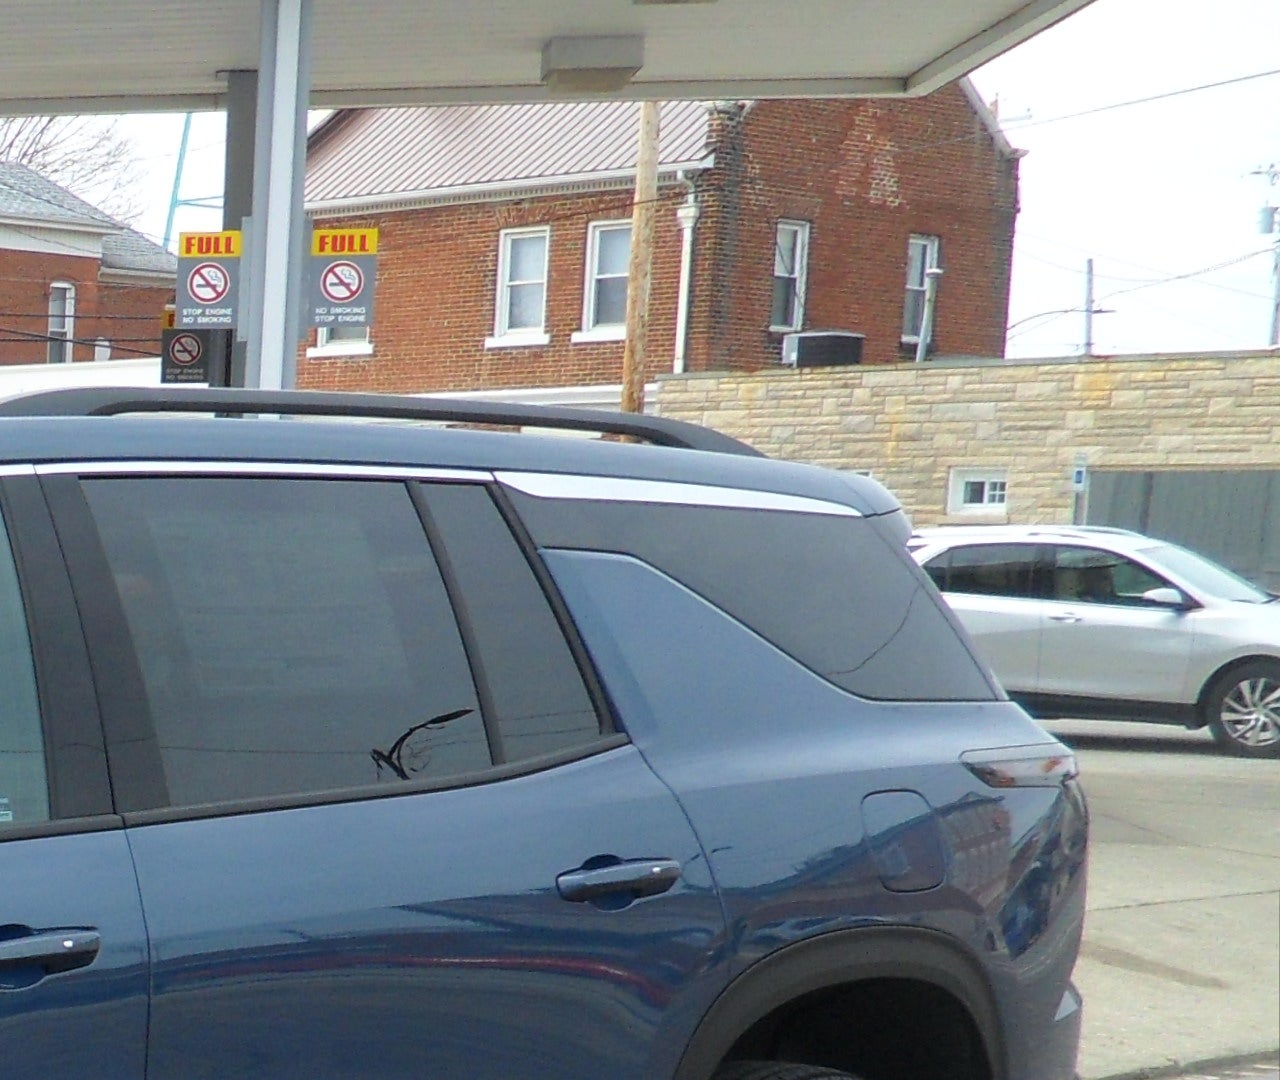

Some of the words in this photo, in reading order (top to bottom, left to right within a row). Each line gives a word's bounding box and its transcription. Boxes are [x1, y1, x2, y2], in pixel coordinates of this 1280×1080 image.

[185, 236, 235, 254] FULL
[318, 234, 369, 253] FULL
[182, 308, 202, 316] STOP
[205, 308, 233, 316] ENGINE
